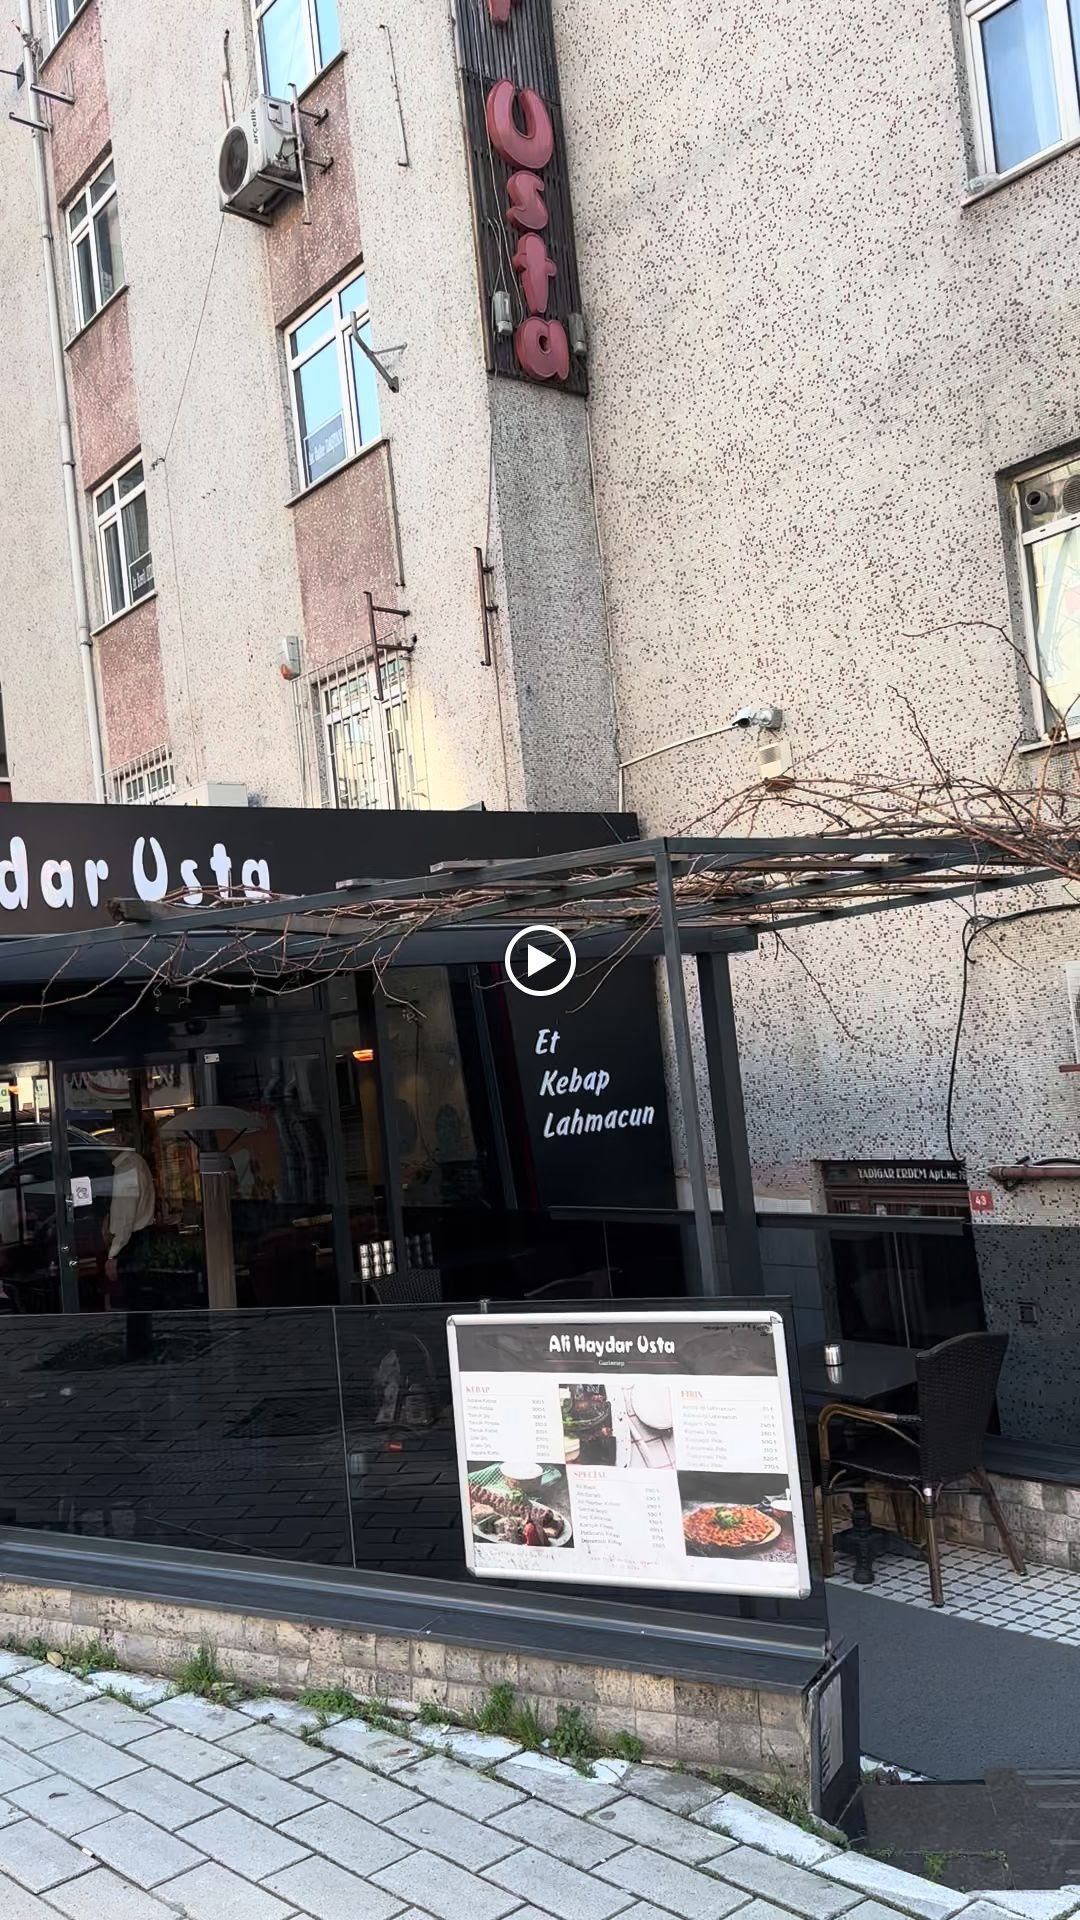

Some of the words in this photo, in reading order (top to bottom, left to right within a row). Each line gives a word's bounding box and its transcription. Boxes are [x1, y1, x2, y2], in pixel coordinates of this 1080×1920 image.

[486, 78, 570, 380] Usta
[132, 836, 271, 905] Usta
[535, 1028, 560, 1055] Et
[539, 1067, 610, 1097] Kebap
[543, 1106, 655, 1139] Lahmacun
[975, 1195, 987, 1206] 43
[549, 1335, 571, 1353] Ali
[573, 1335, 634, 1357] Haydar
[637, 1335, 675, 1354] Usta
